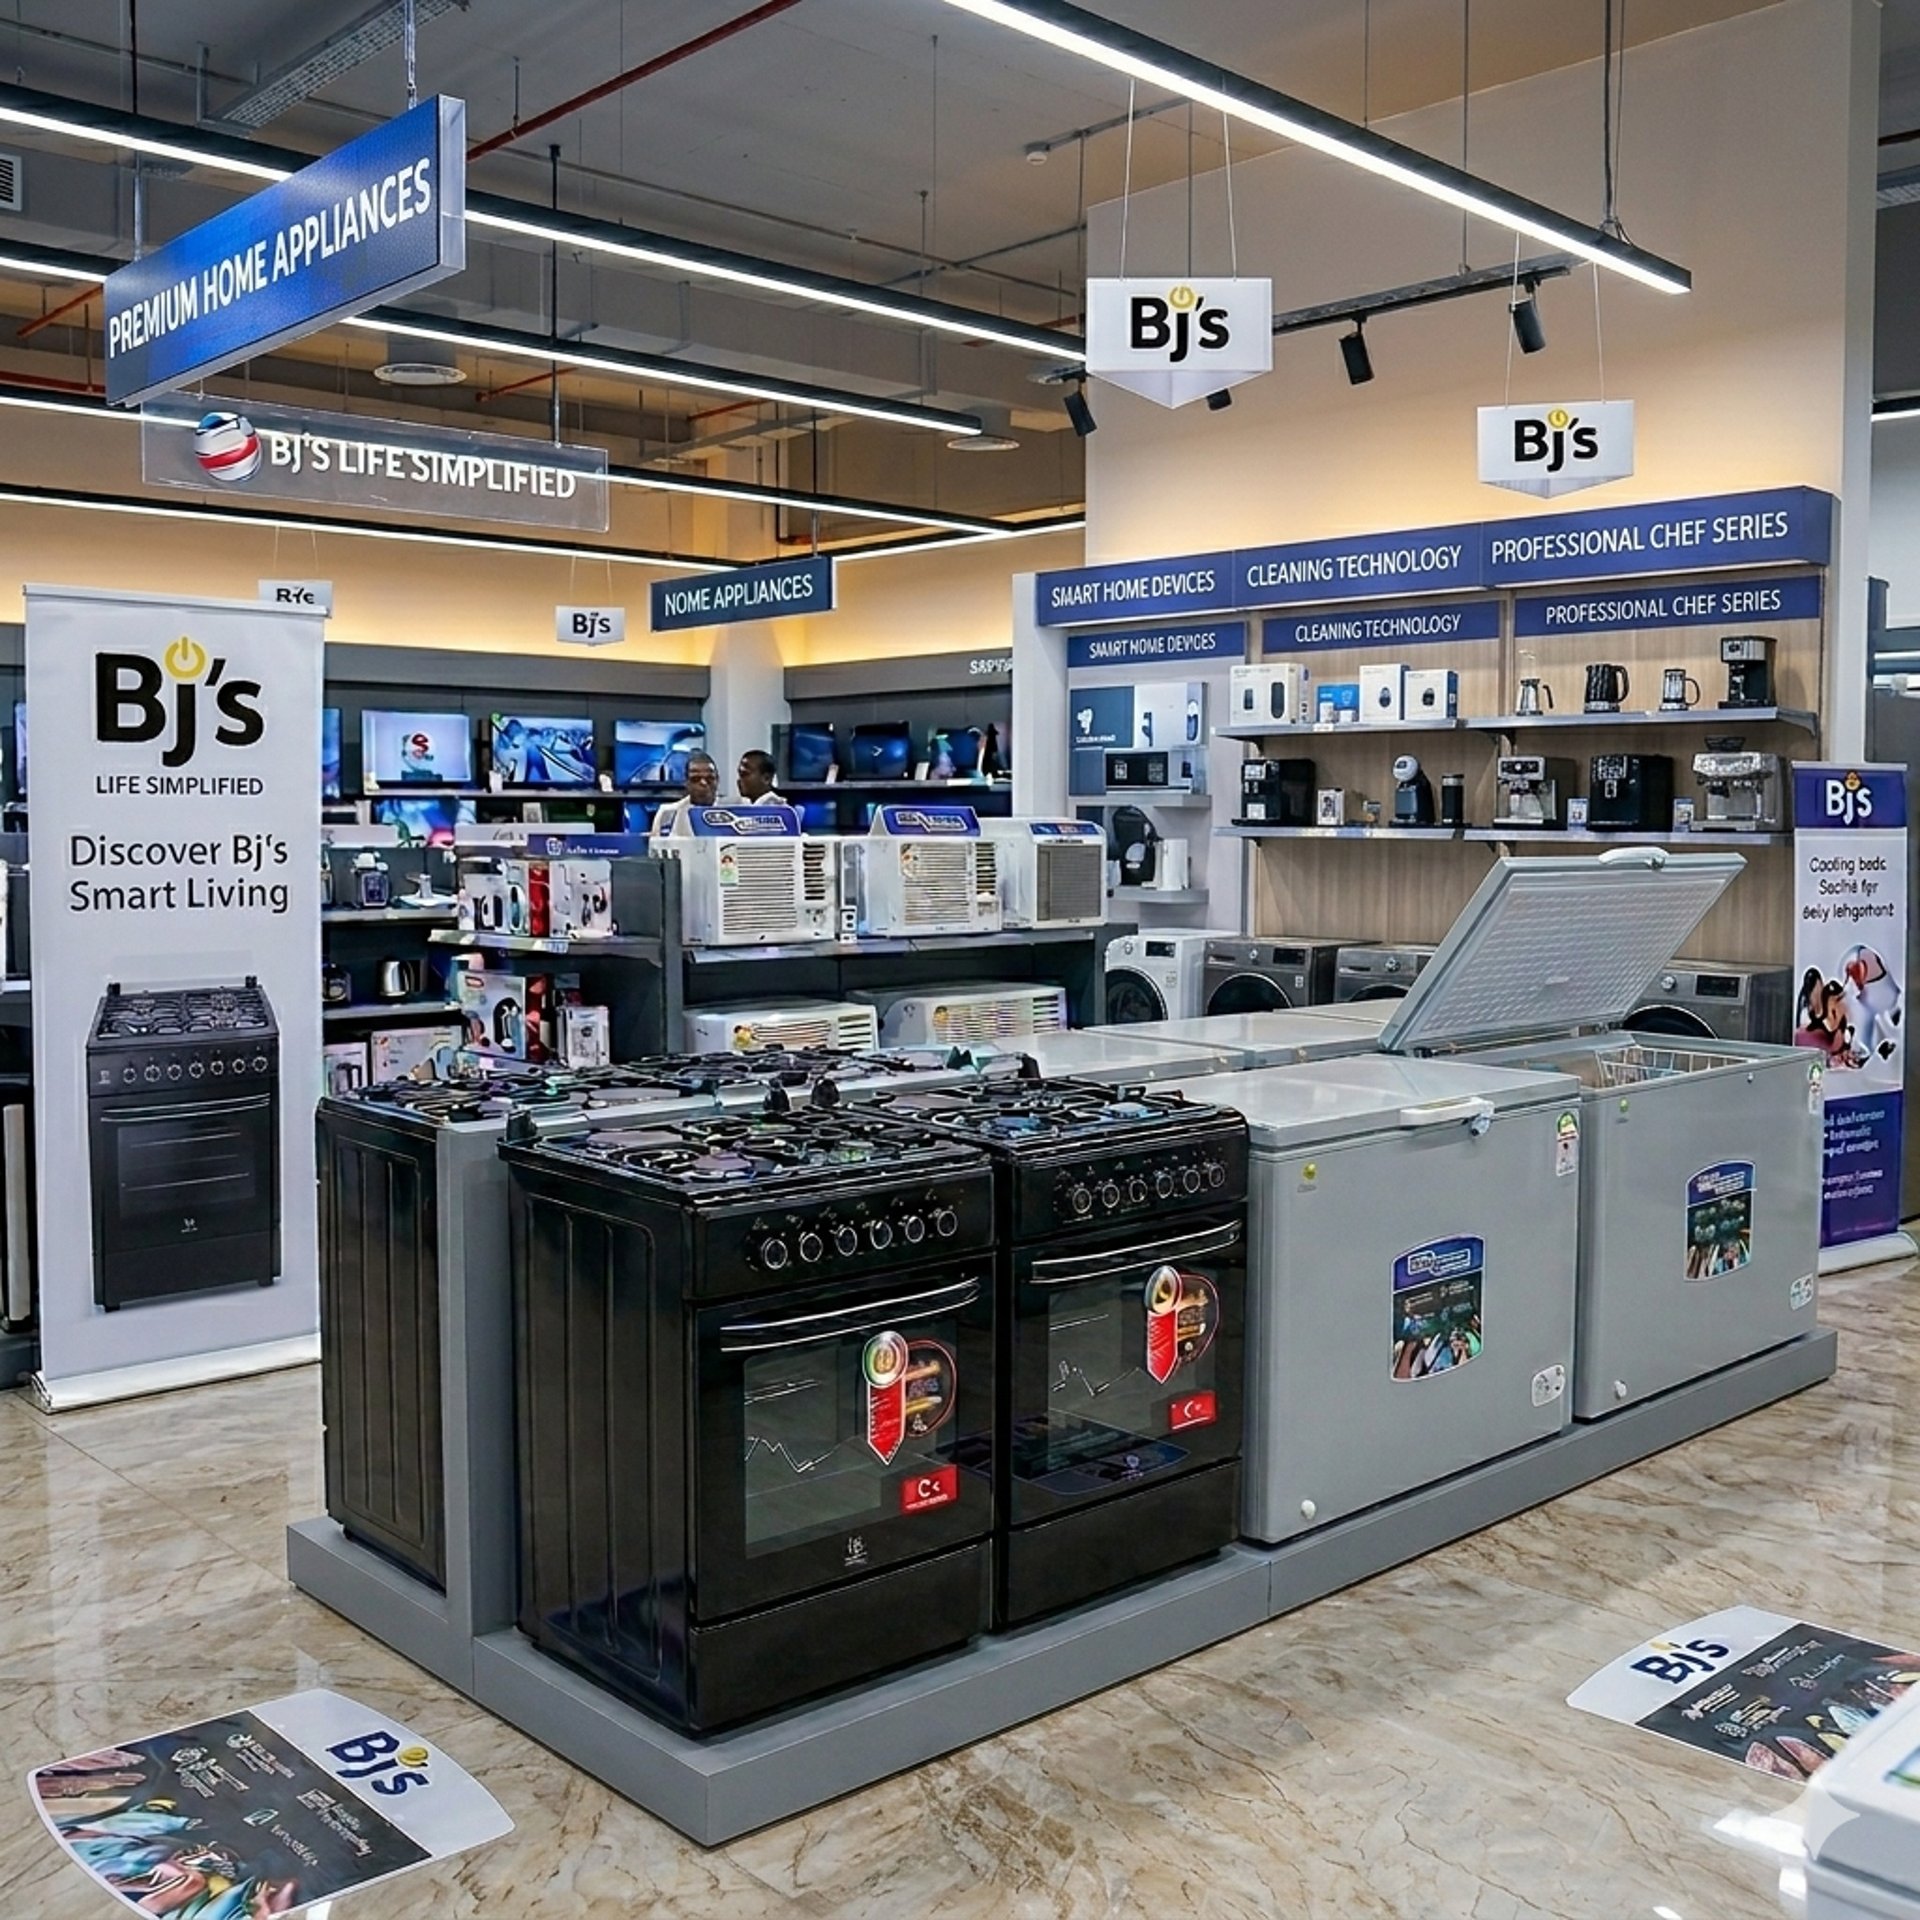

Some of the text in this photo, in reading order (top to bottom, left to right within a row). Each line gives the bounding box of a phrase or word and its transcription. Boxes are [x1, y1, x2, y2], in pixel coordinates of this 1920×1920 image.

[109, 157, 431, 359] PREMIUM HOME APPLIANCES
[1130, 286, 1230, 363] Bj's
[1514, 409, 1599, 472] Bj's
[270, 431, 577, 499] BJ'S LIFE SIMPLIFIED
[1491, 511, 1789, 565] PROFESSIONAL CHEF SERIES
[1247, 545, 1462, 588] CLEANING TECHNOLOGY
[664, 573, 813, 617] NOME APPLIANCES
[1050, 569, 1216, 608] SMART HOME DEVICES
[1546, 589, 1782, 625] PROFESSIONAL CHEF SERIES
[1295, 614, 1461, 643] CLEANING TECHNOLOGY
[95, 636, 264, 768] Bj's
[96, 776, 264, 796] LIFE SIMPLIFIED
[71, 835, 222, 867] Discover
[70, 877, 289, 914] Smart Living
